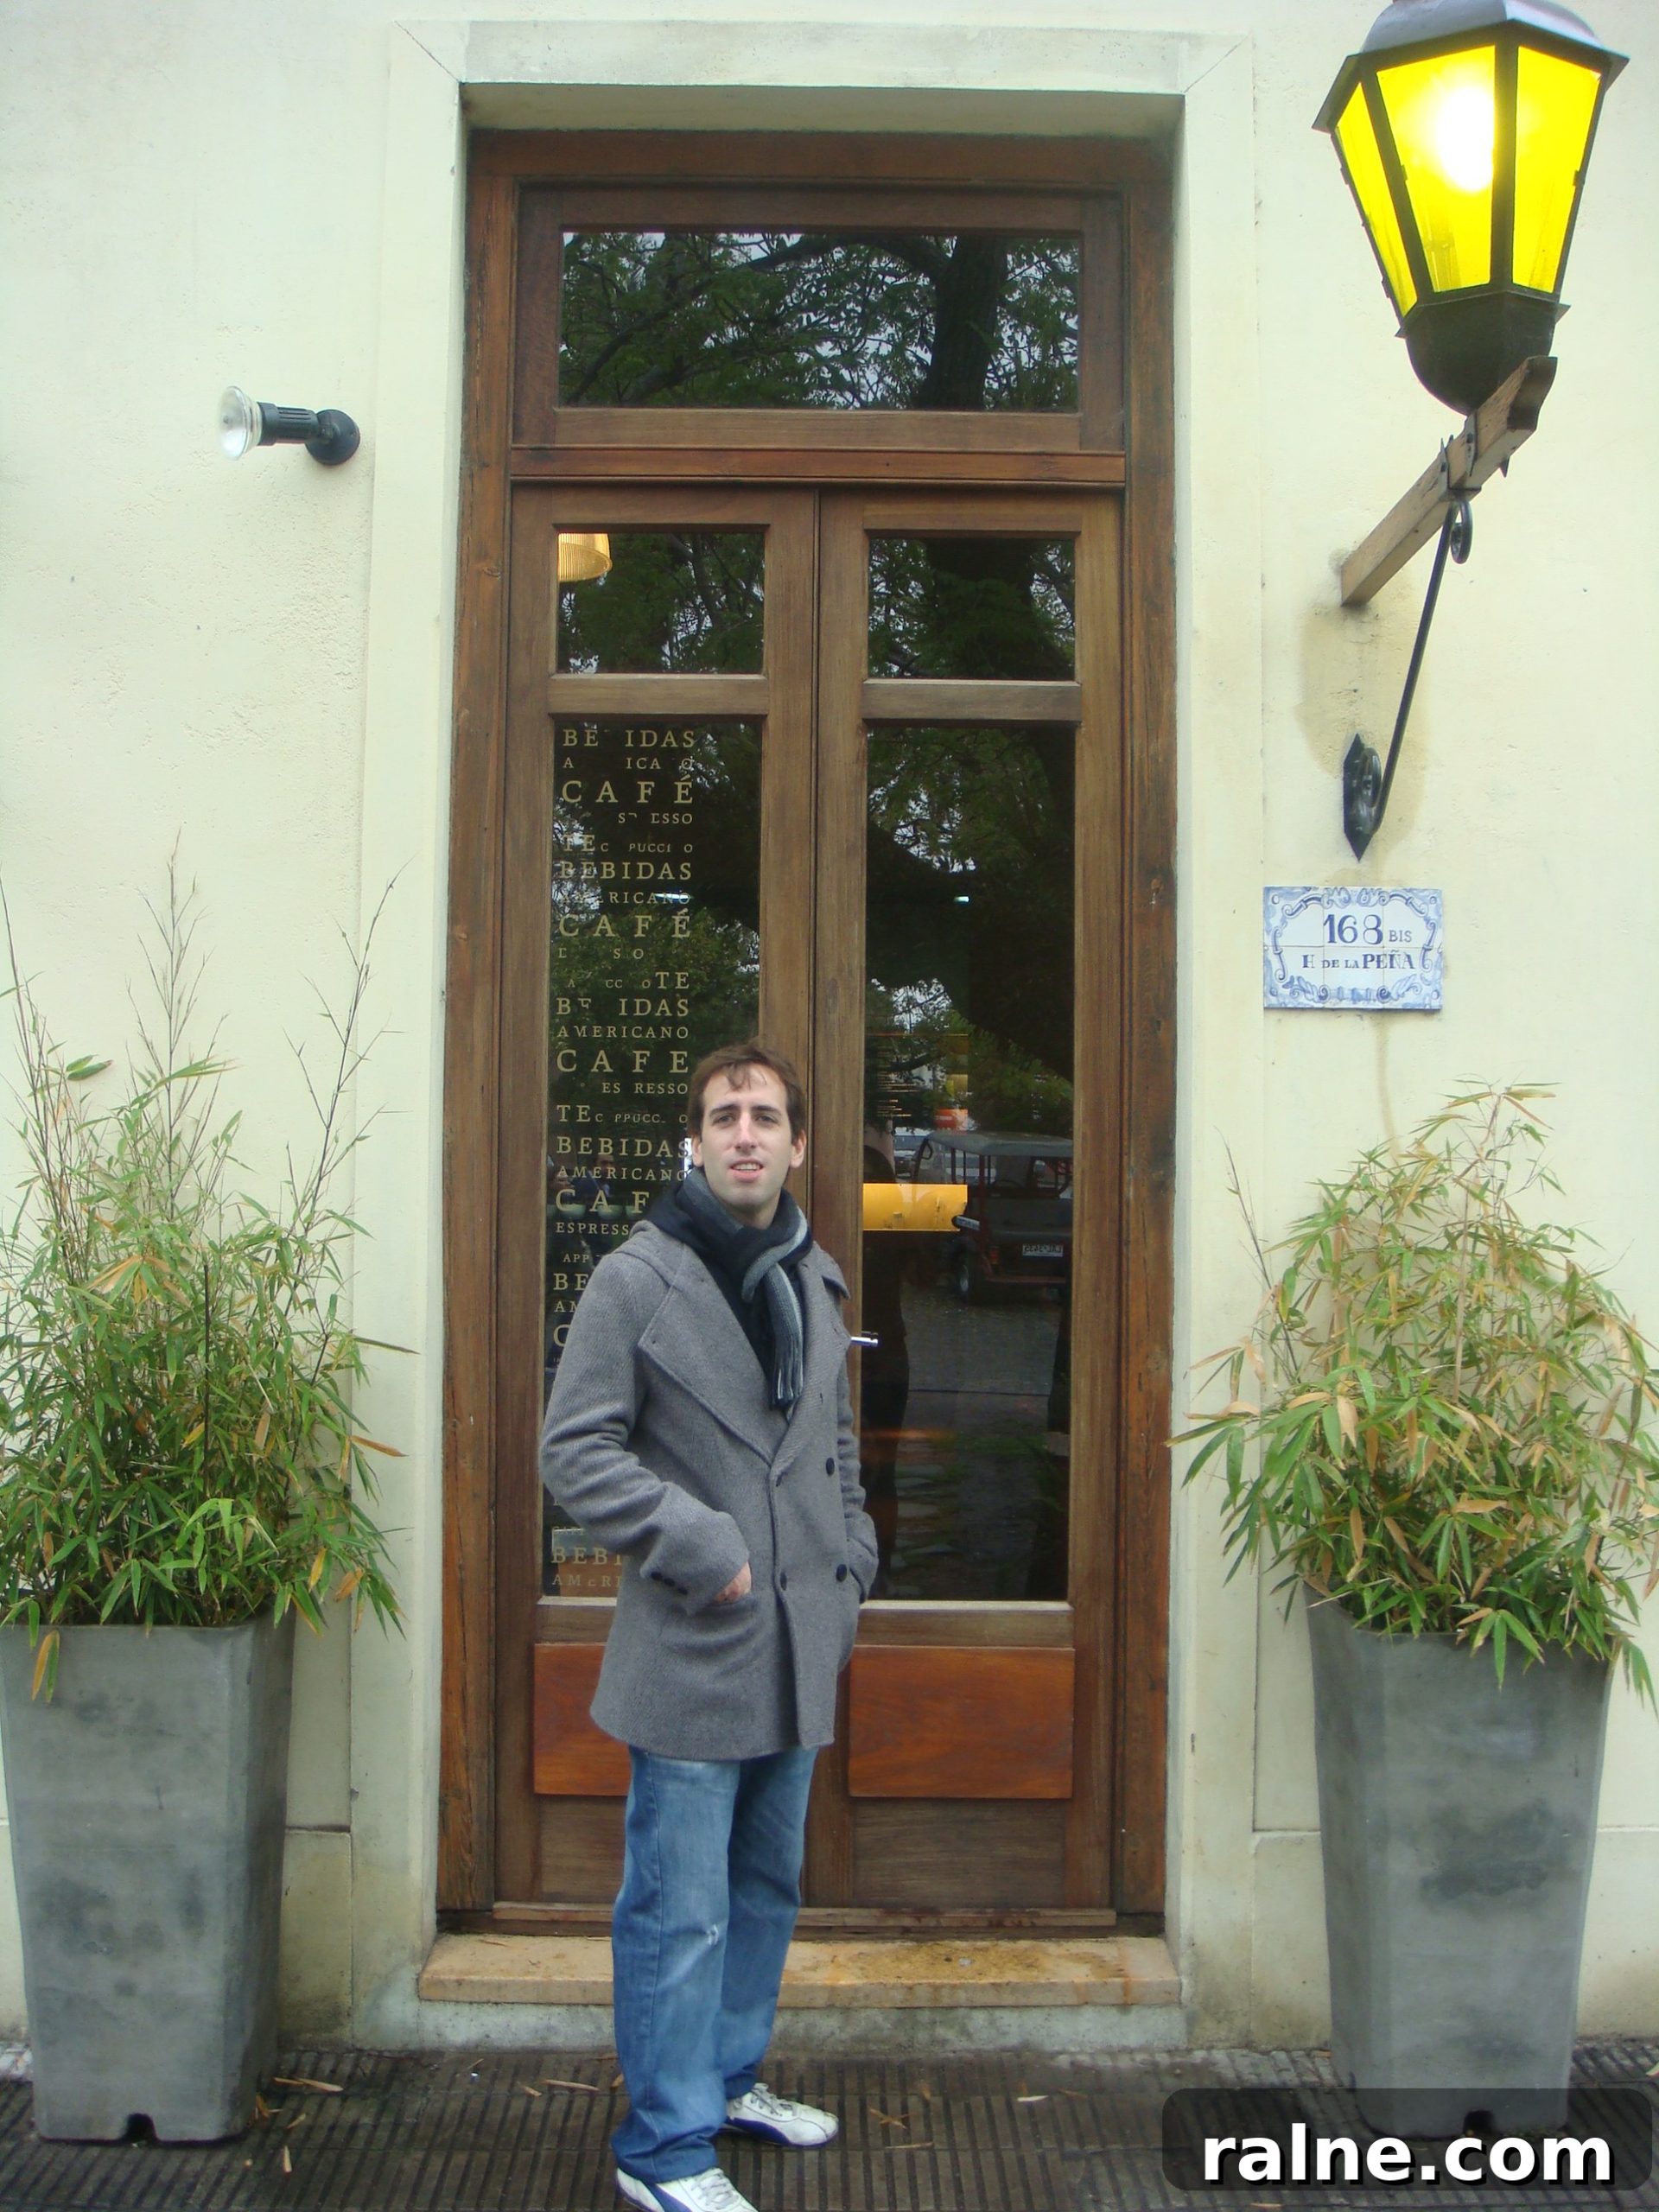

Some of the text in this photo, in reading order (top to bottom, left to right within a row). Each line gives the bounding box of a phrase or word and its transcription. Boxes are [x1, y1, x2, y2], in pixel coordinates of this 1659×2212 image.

[563, 728, 695, 747] BEIDAS
[563, 774, 693, 804] CAFÉ
[560, 861, 691, 880] BEBIDAS
[559, 908, 690, 938] CAFÉ
[1323, 914, 1412, 944] 168 BIS
[1322, 958, 1339, 969] DE
[1344, 958, 1359, 969] LA
[1363, 950, 1415, 969] PEÑA
[655, 972, 689, 989] TE
[556, 1026, 689, 1039] AMERICANO
[556, 1050, 689, 1073] CAFE
[601, 1083, 689, 1095] ESRESSO
[556, 1104, 591, 1122] TE
[556, 1136, 690, 1159] BEBIDAS
[556, 1189, 650, 1214] CAF
[556, 1222, 629, 1236] ESPRESS
